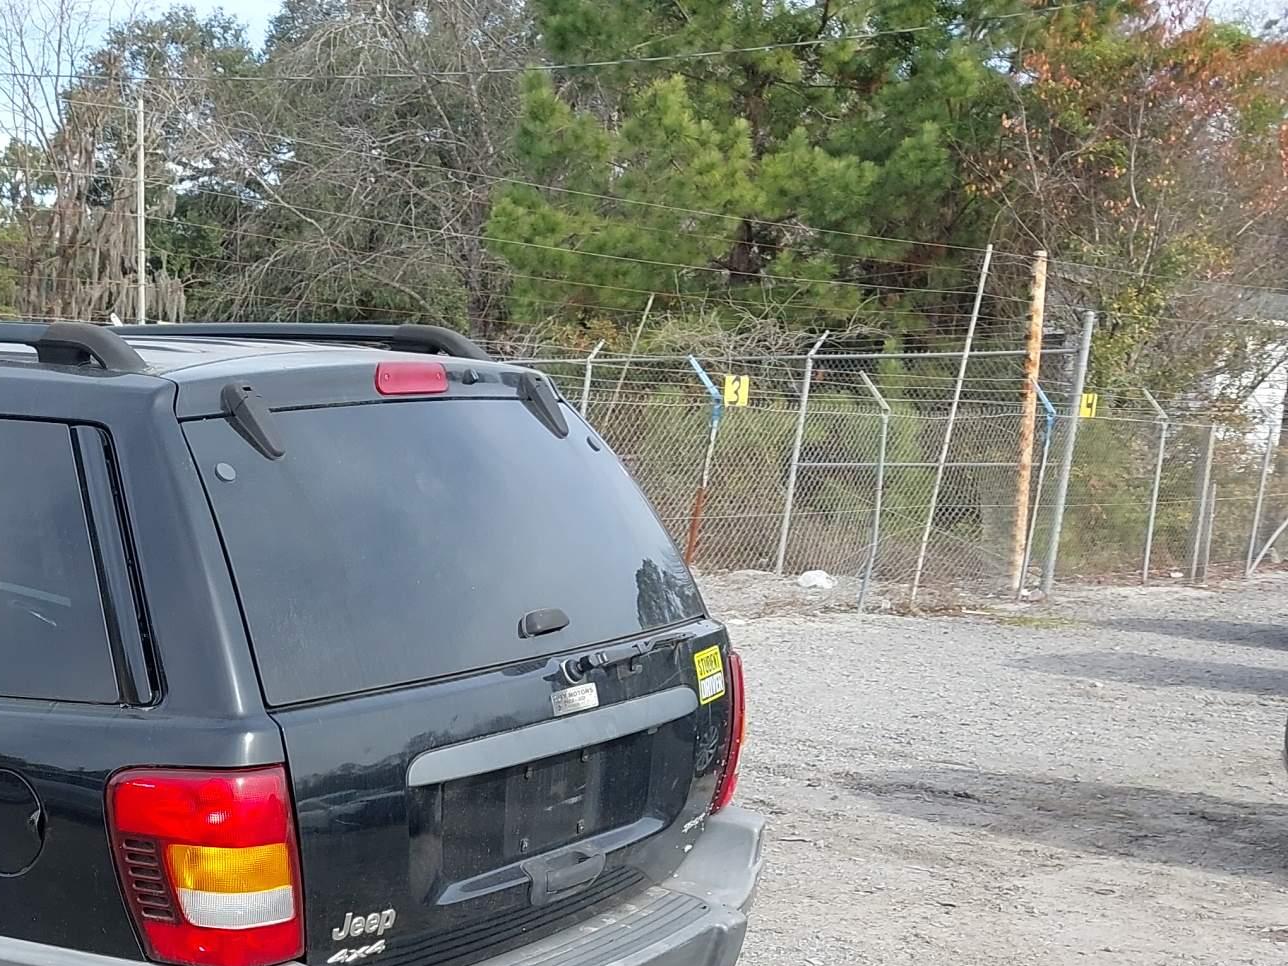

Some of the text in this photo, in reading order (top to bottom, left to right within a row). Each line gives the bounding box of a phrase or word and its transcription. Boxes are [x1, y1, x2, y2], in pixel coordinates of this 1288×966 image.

[727, 375, 741, 405] 3
[697, 651, 721, 676] STUDENT
[332, 908, 396, 941] Jeep
